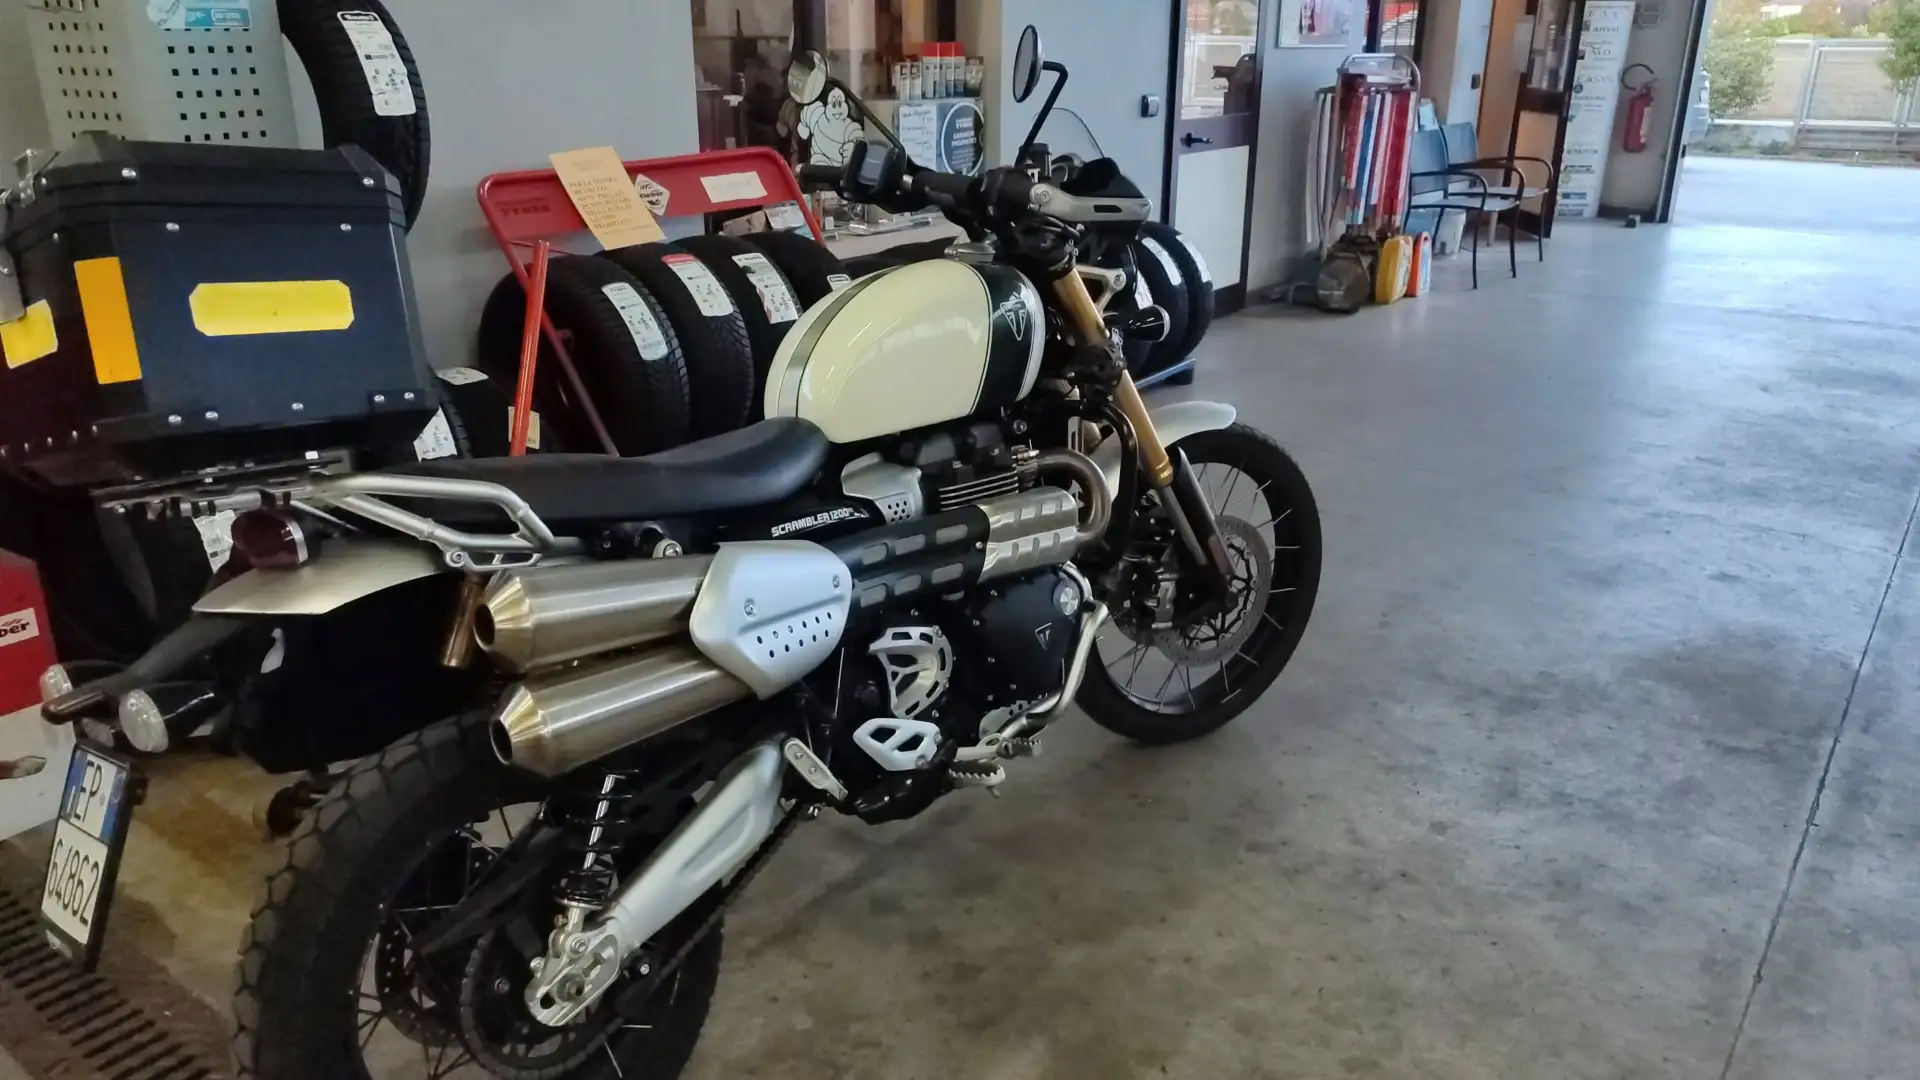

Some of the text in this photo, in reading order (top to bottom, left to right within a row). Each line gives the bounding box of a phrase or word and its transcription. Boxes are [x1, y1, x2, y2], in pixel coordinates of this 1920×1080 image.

[771, 508, 850, 538] SCRAMBLER 1200
[73, 759, 103, 823] EP
[47, 838, 100, 928] 64862
